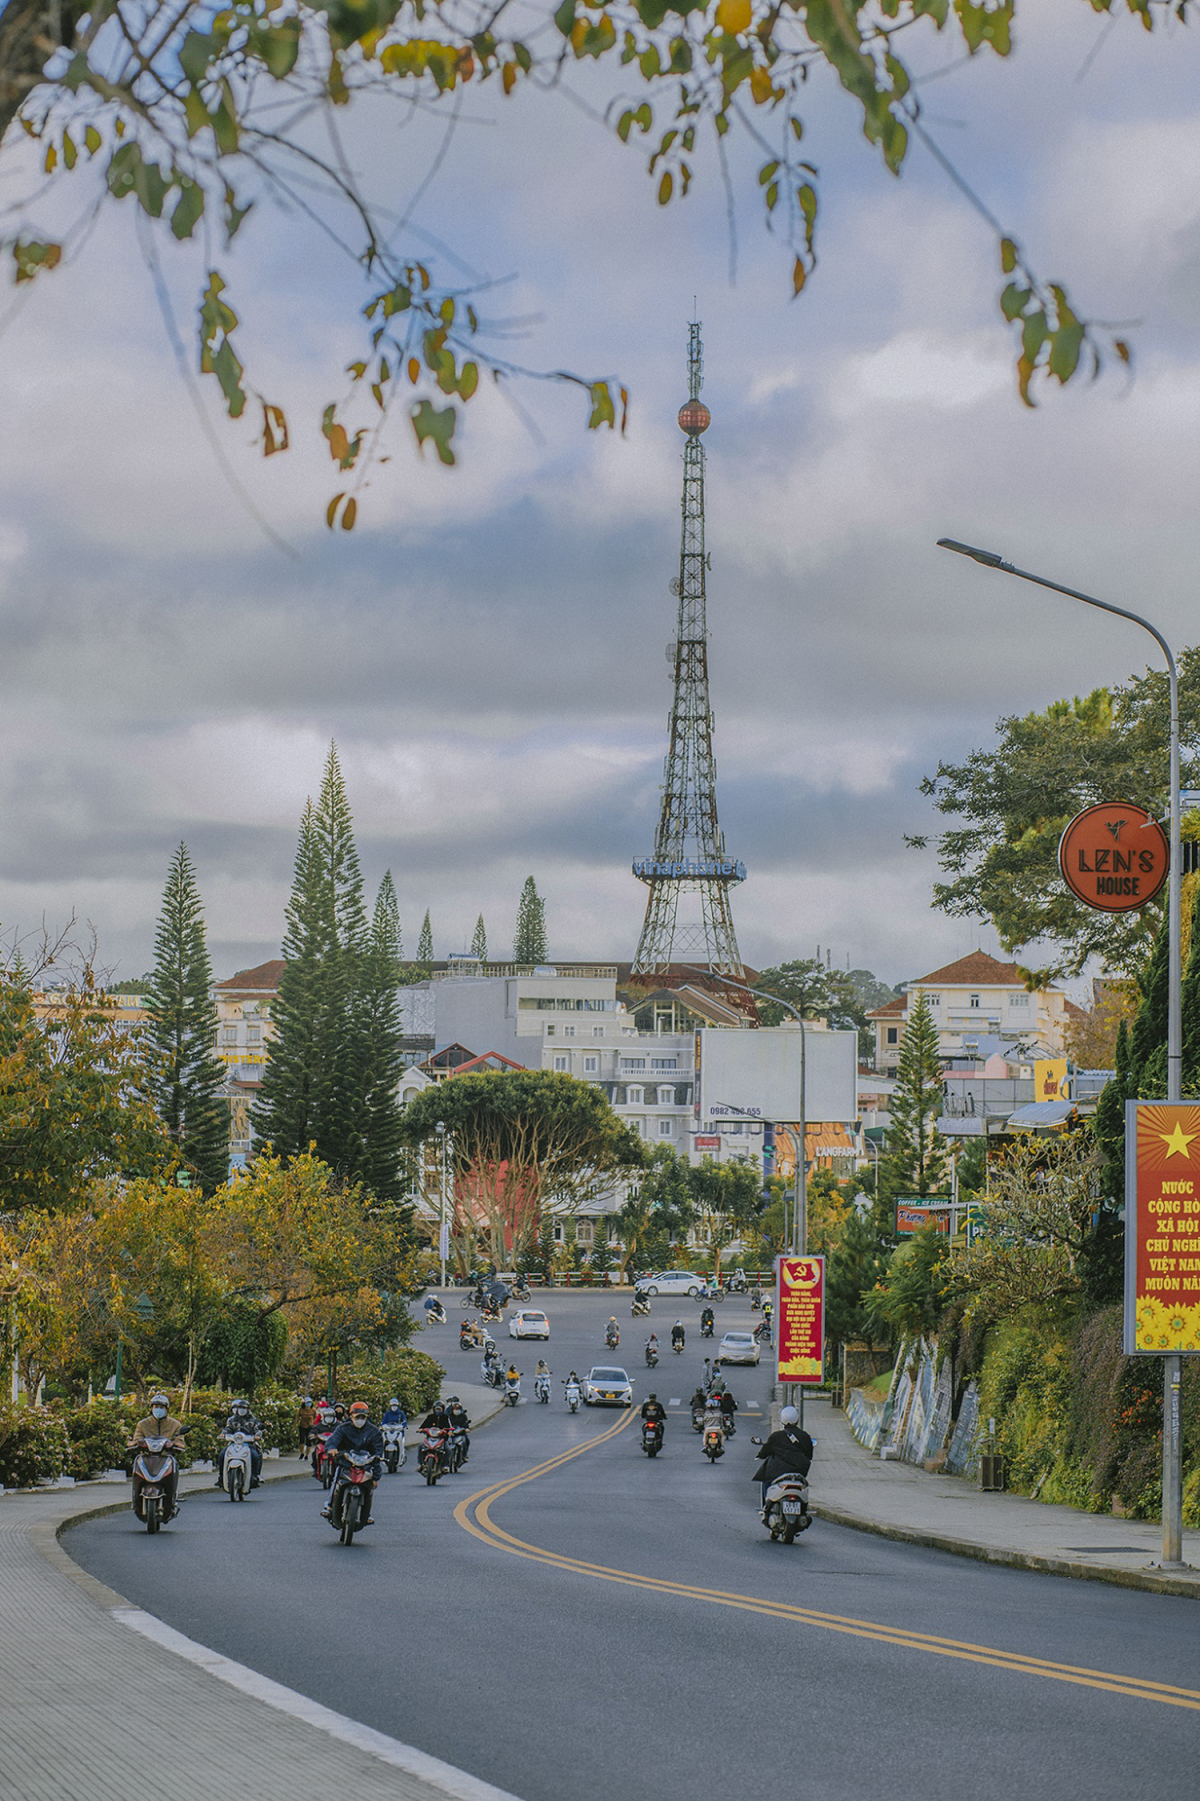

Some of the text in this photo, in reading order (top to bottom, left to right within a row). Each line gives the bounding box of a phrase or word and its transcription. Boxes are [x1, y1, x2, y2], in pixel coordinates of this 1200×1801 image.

[1079, 849, 1154, 873] LEN'S
[1097, 876, 1140, 895] HOUSE
[710, 1106, 729, 1115] 0982
[747, 1106, 761, 1115] 655
[1148, 1197, 1181, 1216] CỘNG
[1156, 1217, 1199, 1235] XÃ HỘI
[1146, 1235, 1169, 1252] CHỦ
[1149, 1255, 1176, 1274] VIỆT
[1145, 1274, 1200, 1290] MUÔN NĂ
